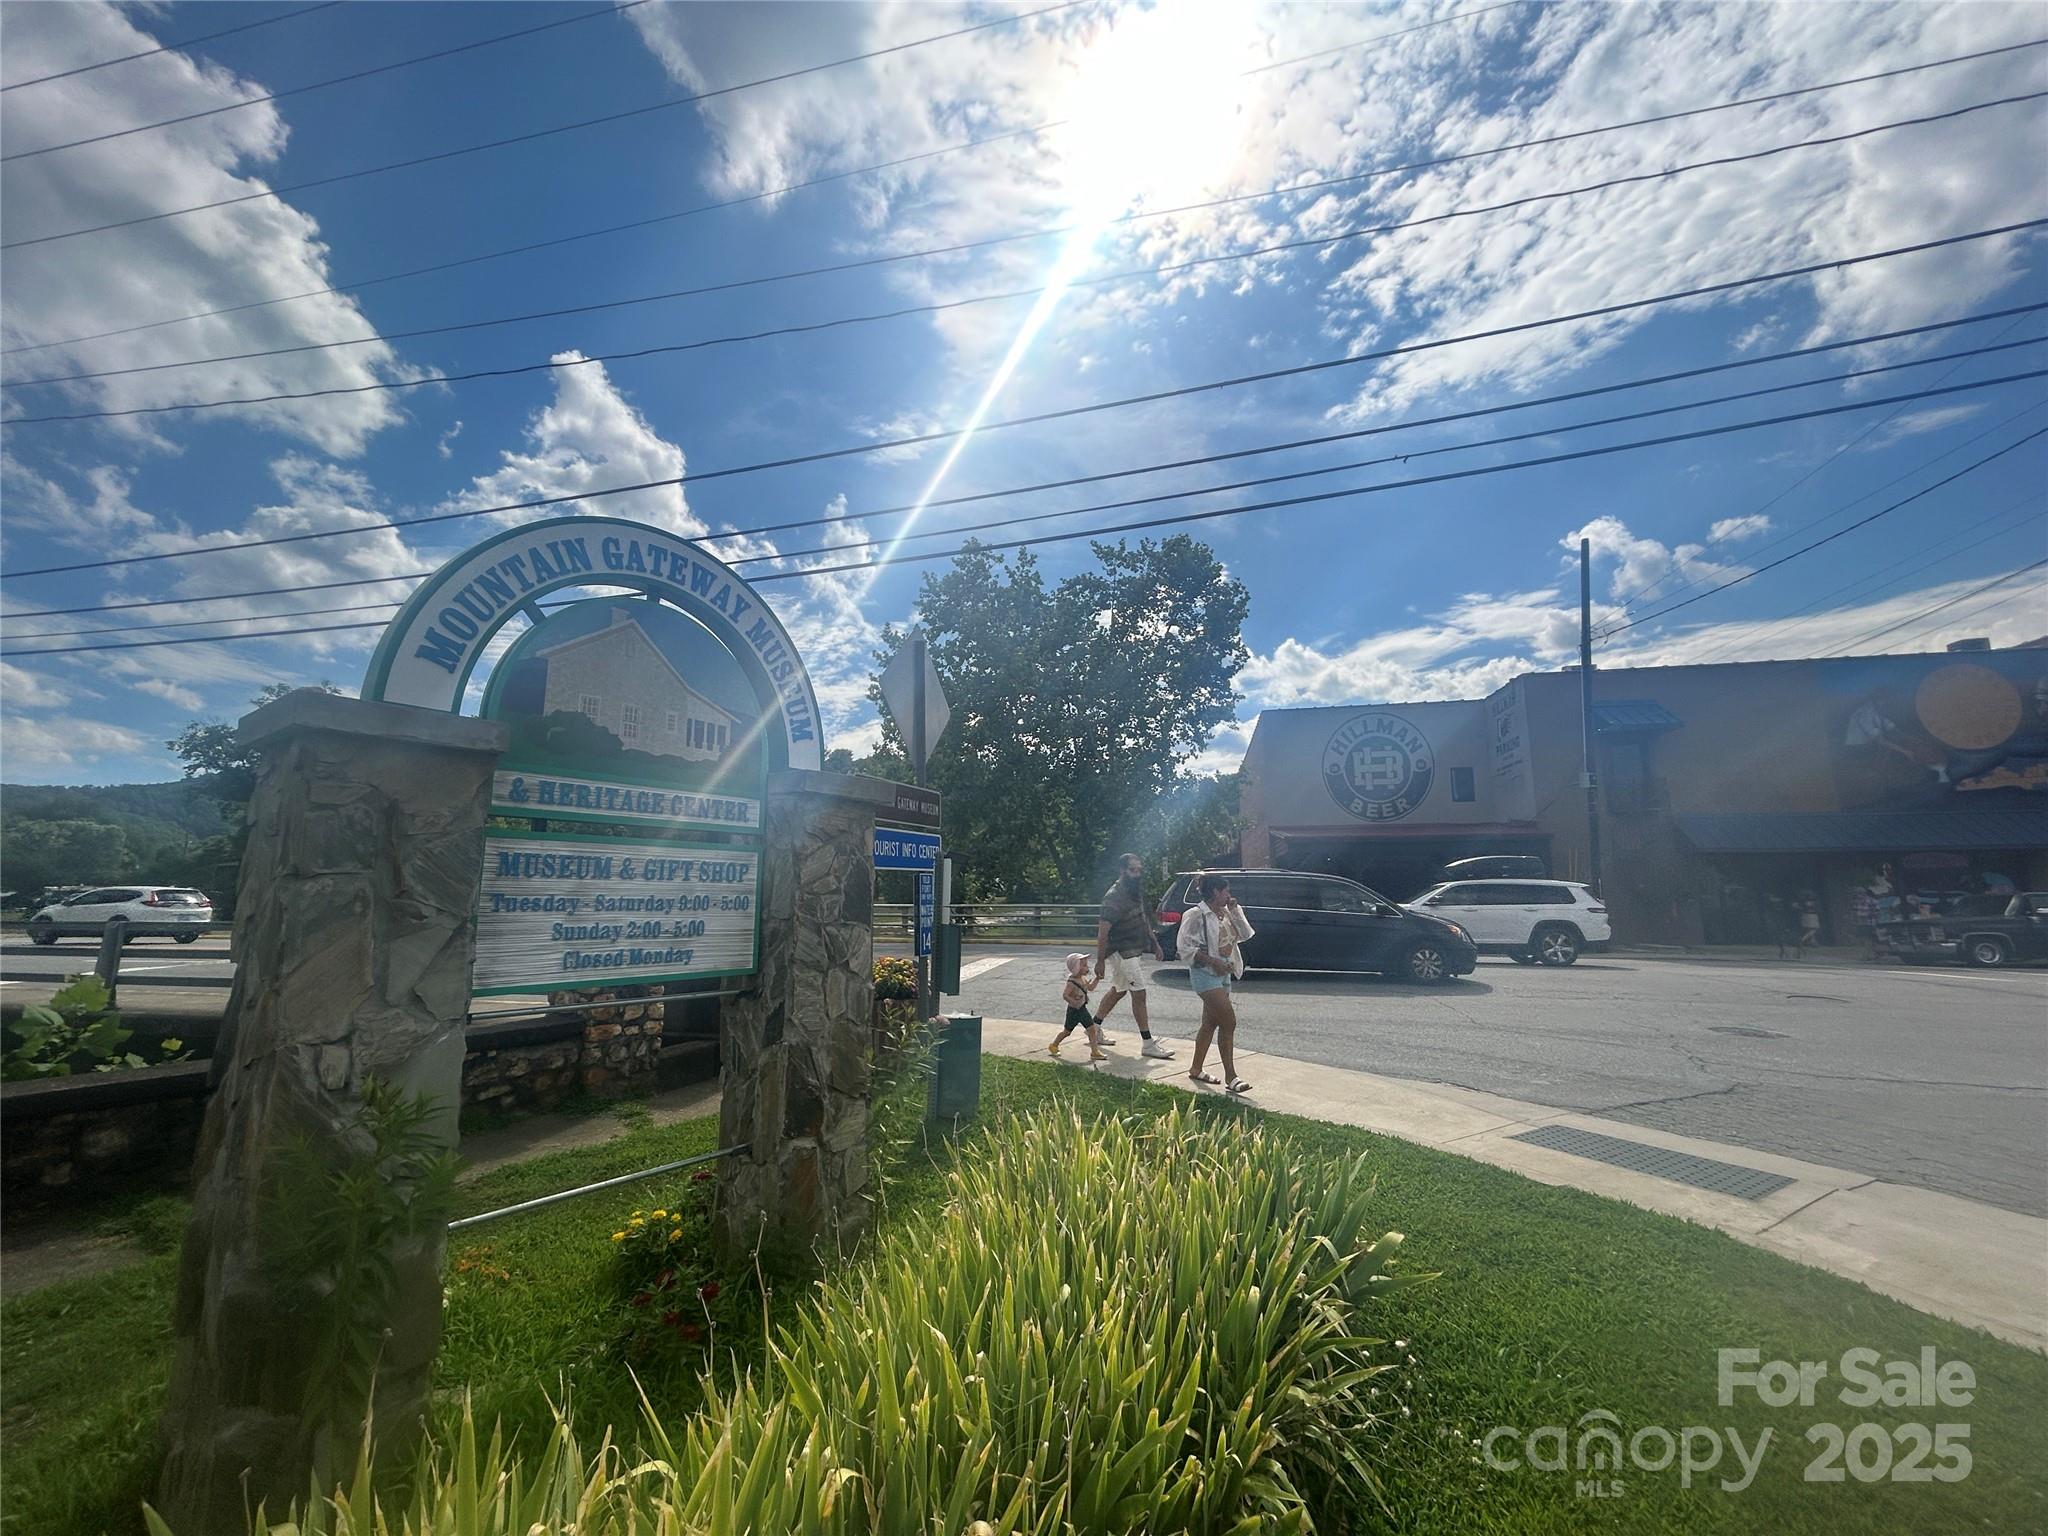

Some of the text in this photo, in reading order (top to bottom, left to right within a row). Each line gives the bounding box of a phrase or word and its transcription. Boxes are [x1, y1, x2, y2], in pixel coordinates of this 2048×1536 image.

[415, 536, 814, 744] MOUNTAIN GATEWAY MUSEUM
[1330, 719, 1424, 756] HILLMAN
[508, 777, 750, 822] & HERITAGE CENTER
[1349, 798, 1410, 818] BEER
[874, 839, 900, 857] OURIST
[902, 842, 917, 858] INFO
[495, 851, 750, 884] MUSEUM & GIFT SHOP
[489, 893, 581, 916] Tuesday
[594, 894, 675, 915] Saturday
[678, 894, 710, 911] 9:00
[720, 895, 750, 911] 5:00
[551, 921, 623, 943] Sunday
[626, 920, 661, 938] 2:00
[672, 920, 705, 938] 5:00
[922, 931, 931, 950] 14
[562, 946, 694, 970] Closed Monday
